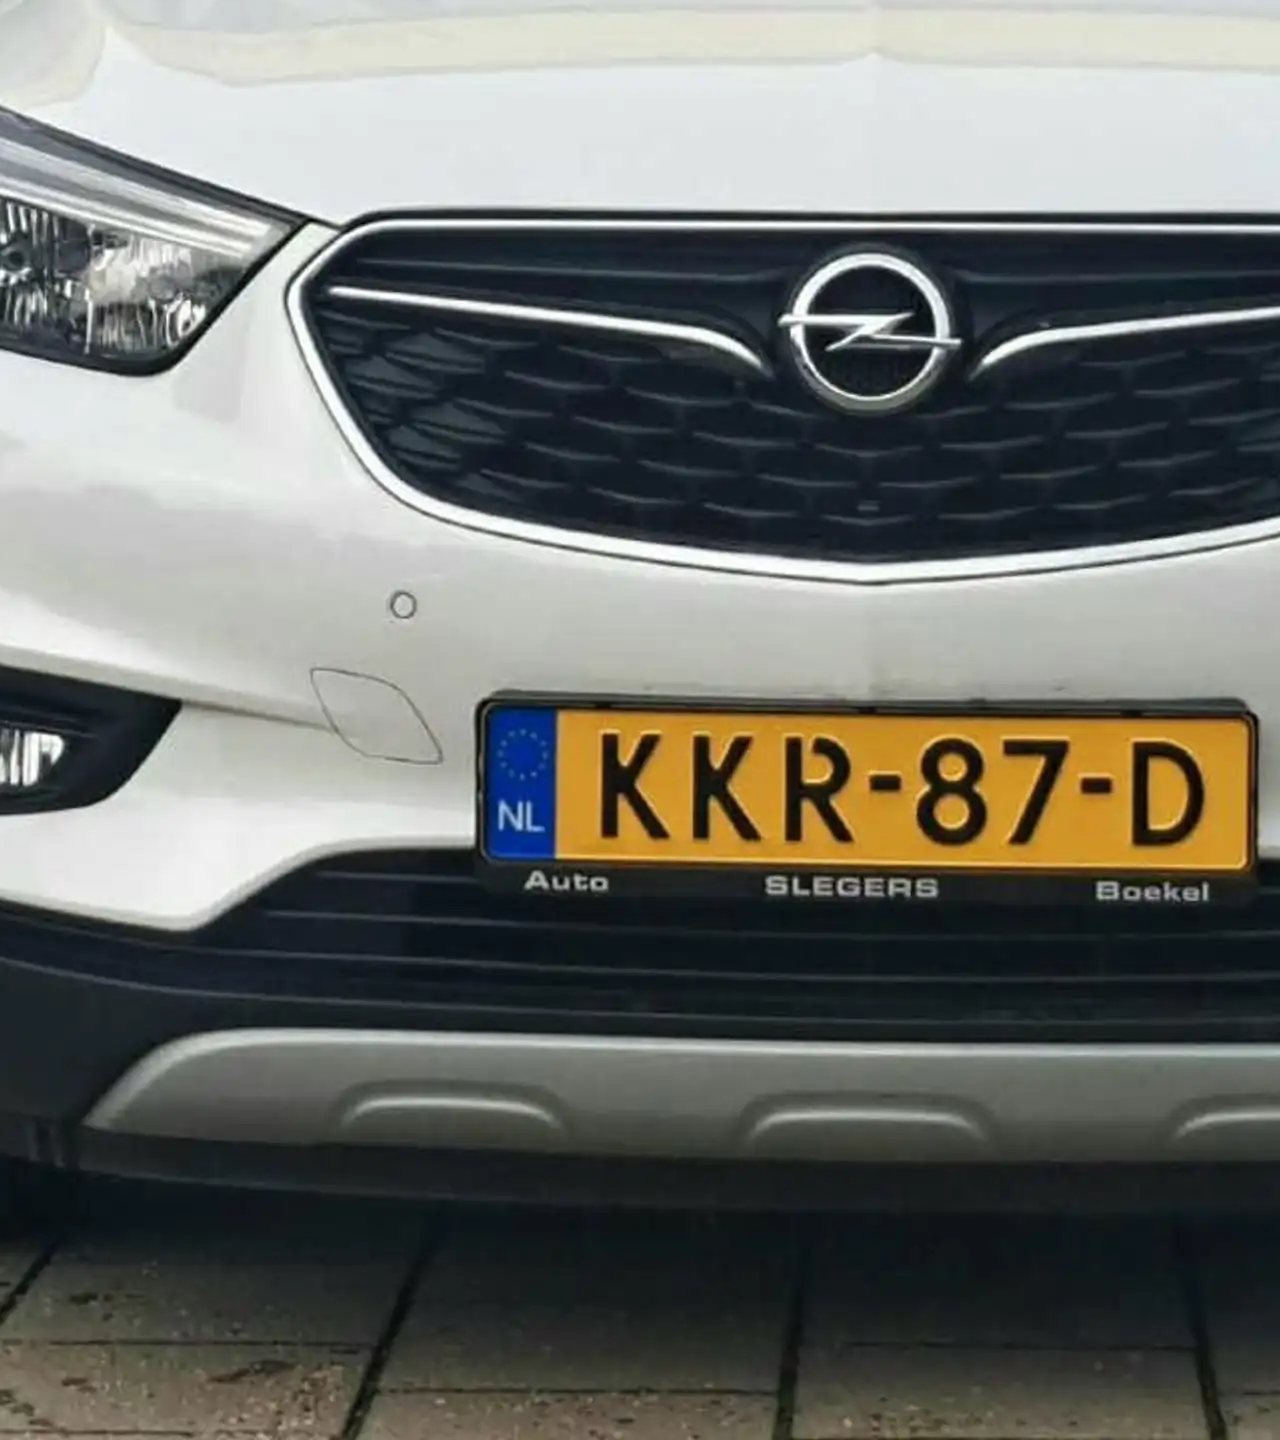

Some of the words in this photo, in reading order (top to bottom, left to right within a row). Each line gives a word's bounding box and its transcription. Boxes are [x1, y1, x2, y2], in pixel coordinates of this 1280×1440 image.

[598, 729, 1205, 847] KKR-87-D
[497, 800, 546, 833] NL
[523, 870, 610, 893] Auto
[764, 875, 940, 899] SLEGERS
[1094, 880, 1211, 903] Boekel
